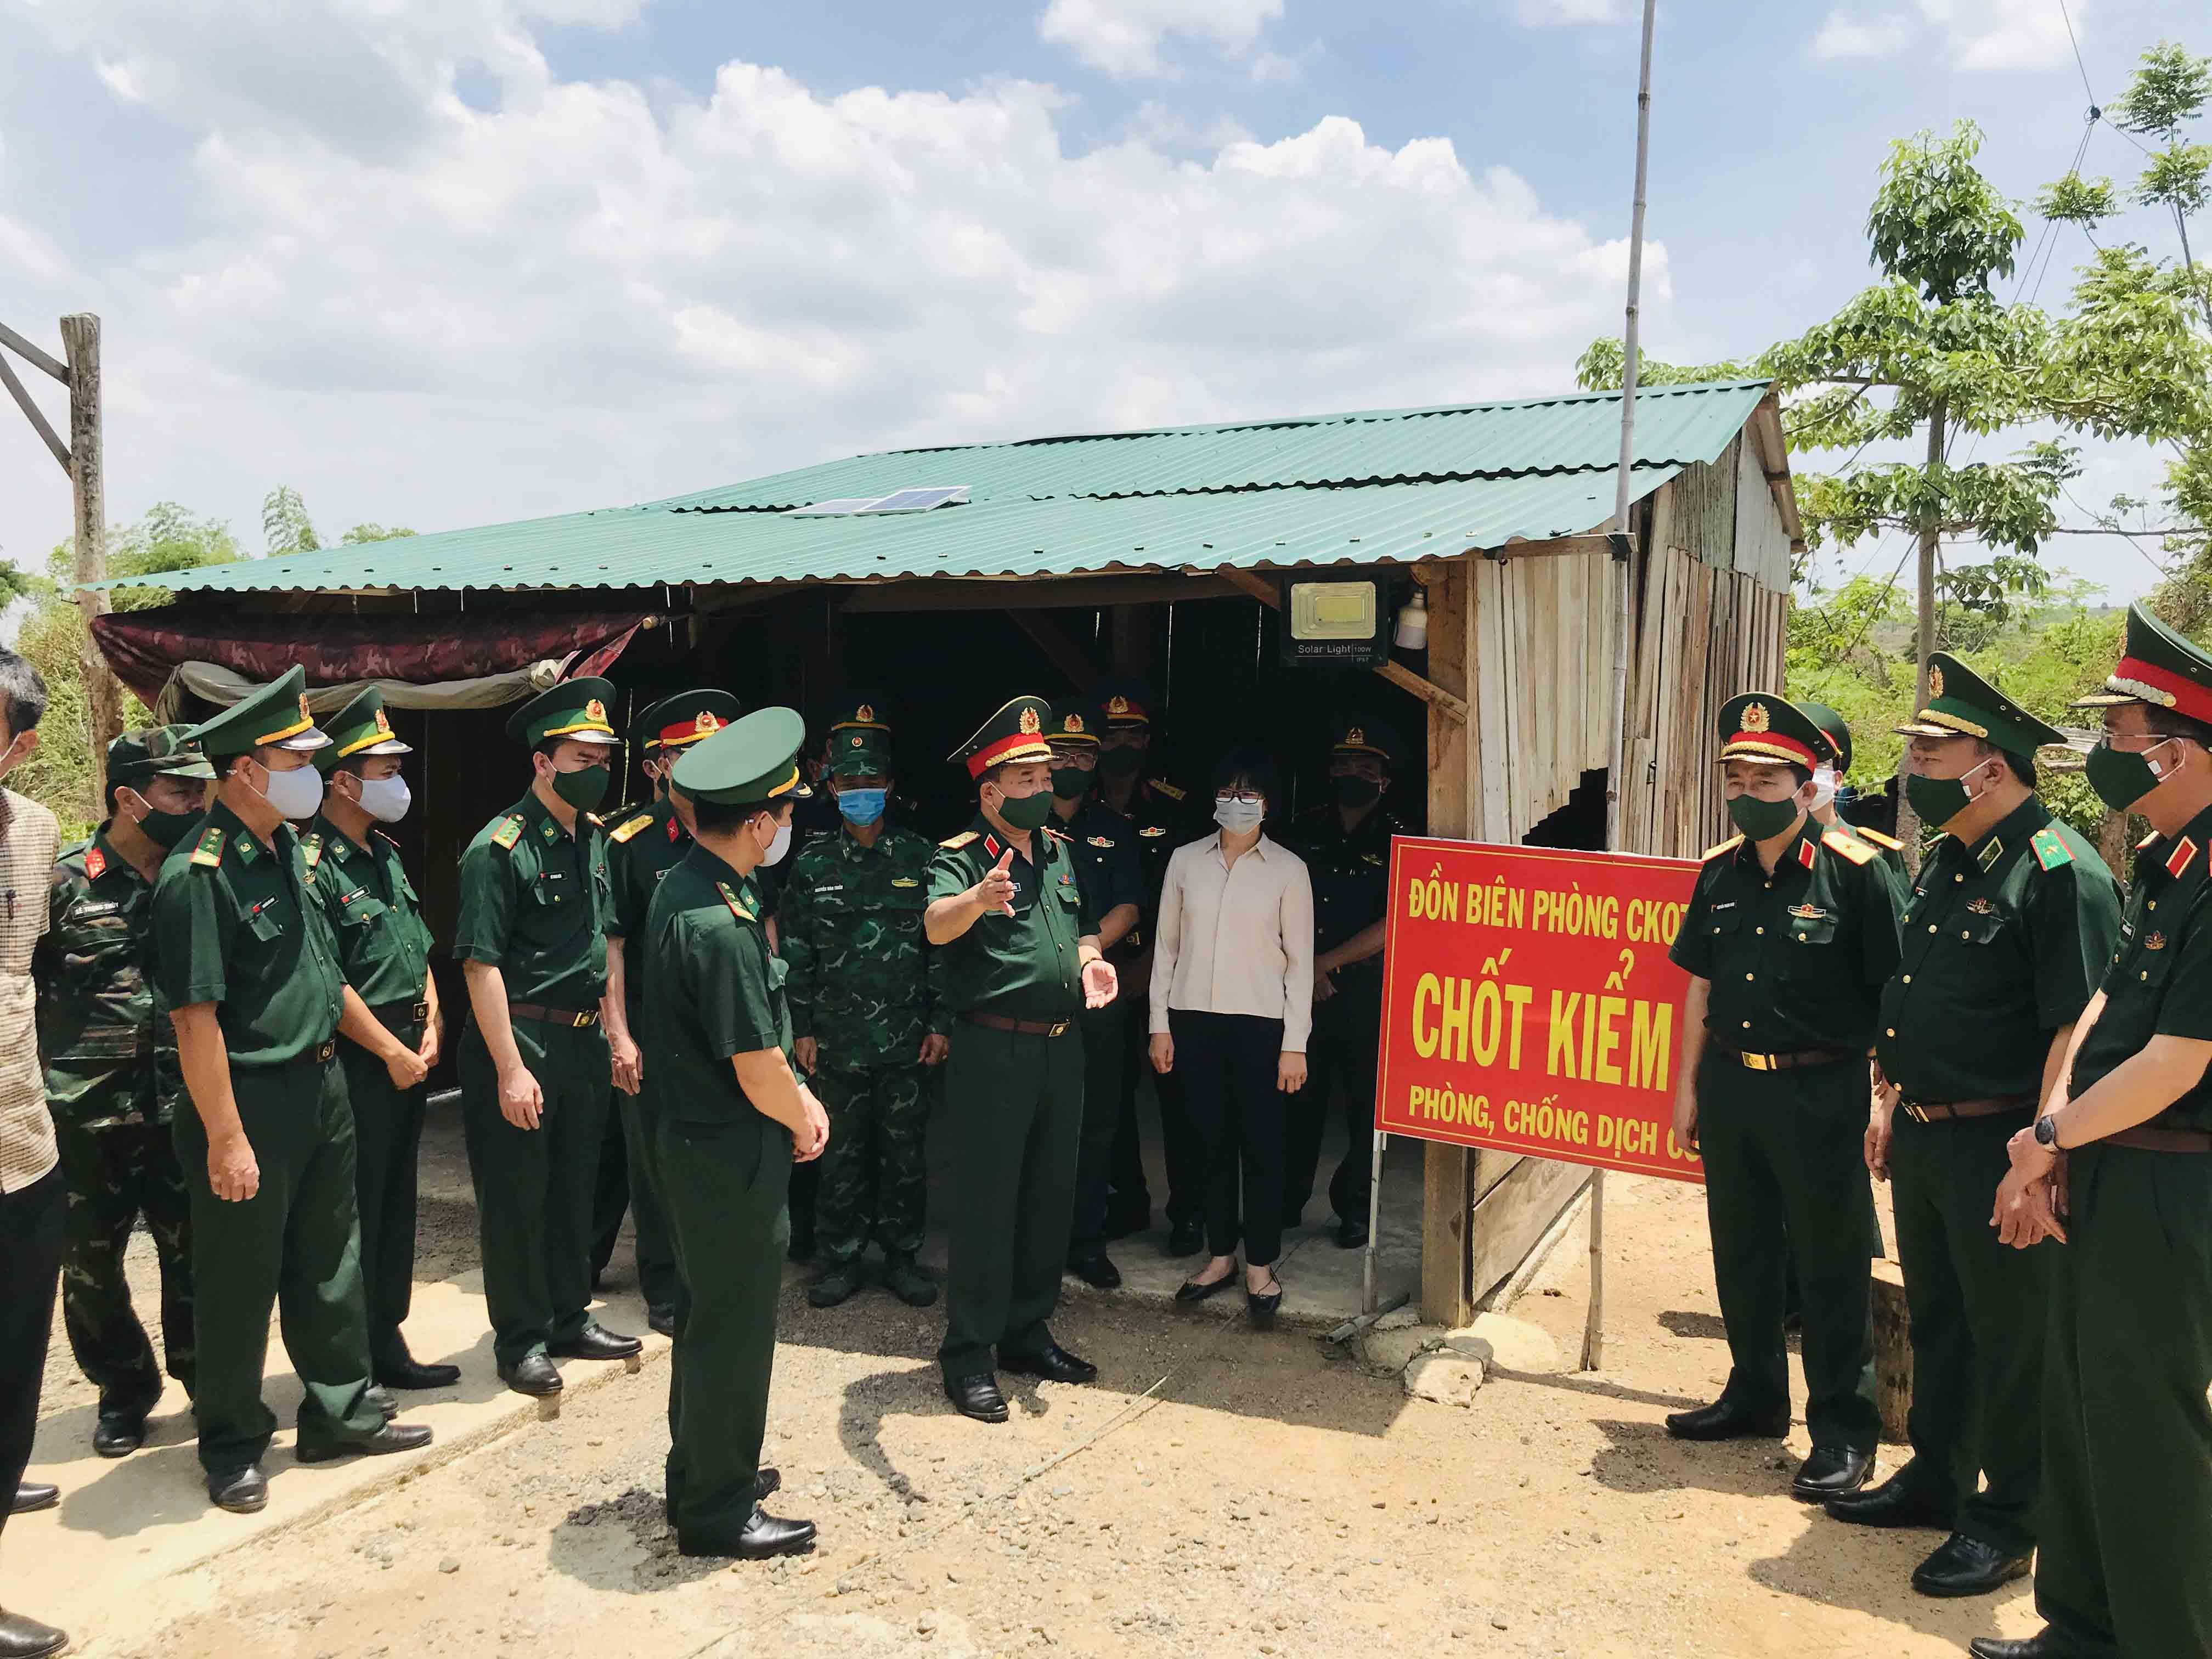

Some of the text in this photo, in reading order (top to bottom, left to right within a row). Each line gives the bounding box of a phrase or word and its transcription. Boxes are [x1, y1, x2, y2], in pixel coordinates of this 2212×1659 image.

[1299, 645, 1323, 653] Solar
[1327, 645, 1351, 654] Light
[1408, 862, 1459, 922] ĐỒN
[1465, 875, 1525, 929] BIÊN
[1532, 882, 1619, 940] PHÒNG
[1412, 947, 1673, 1092] CHỐT KIỂM
[1409, 1081, 1495, 1136] PHÒNG,
[1504, 1094, 1589, 1145] CHỐNG
[1596, 1114, 1658, 1158] DỊCH
